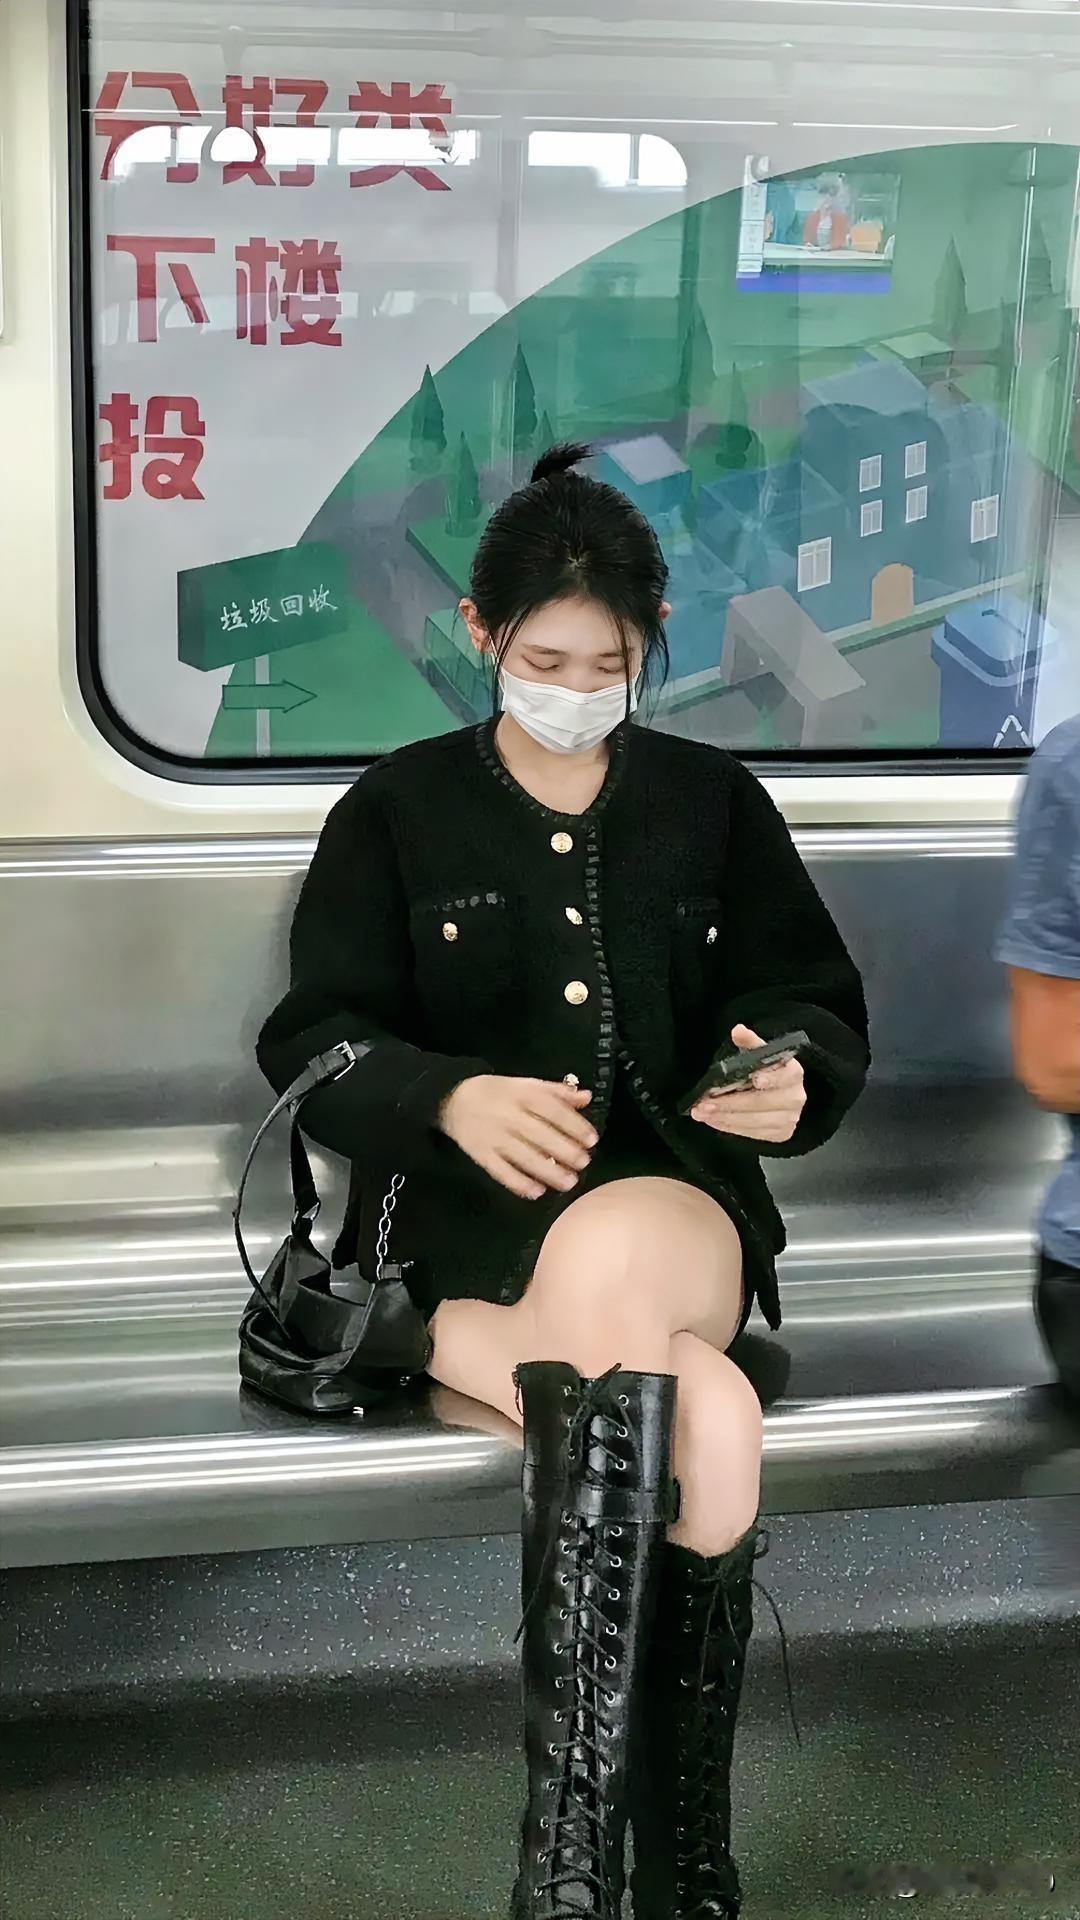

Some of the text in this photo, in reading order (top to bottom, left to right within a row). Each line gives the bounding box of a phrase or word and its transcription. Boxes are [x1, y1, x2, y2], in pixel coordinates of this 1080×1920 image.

[95, 71, 452, 190] 分好类
[106, 234, 342, 346] 下楼
[99, 393, 205, 500] 投
[219, 584, 338, 631] 垃圾回收
